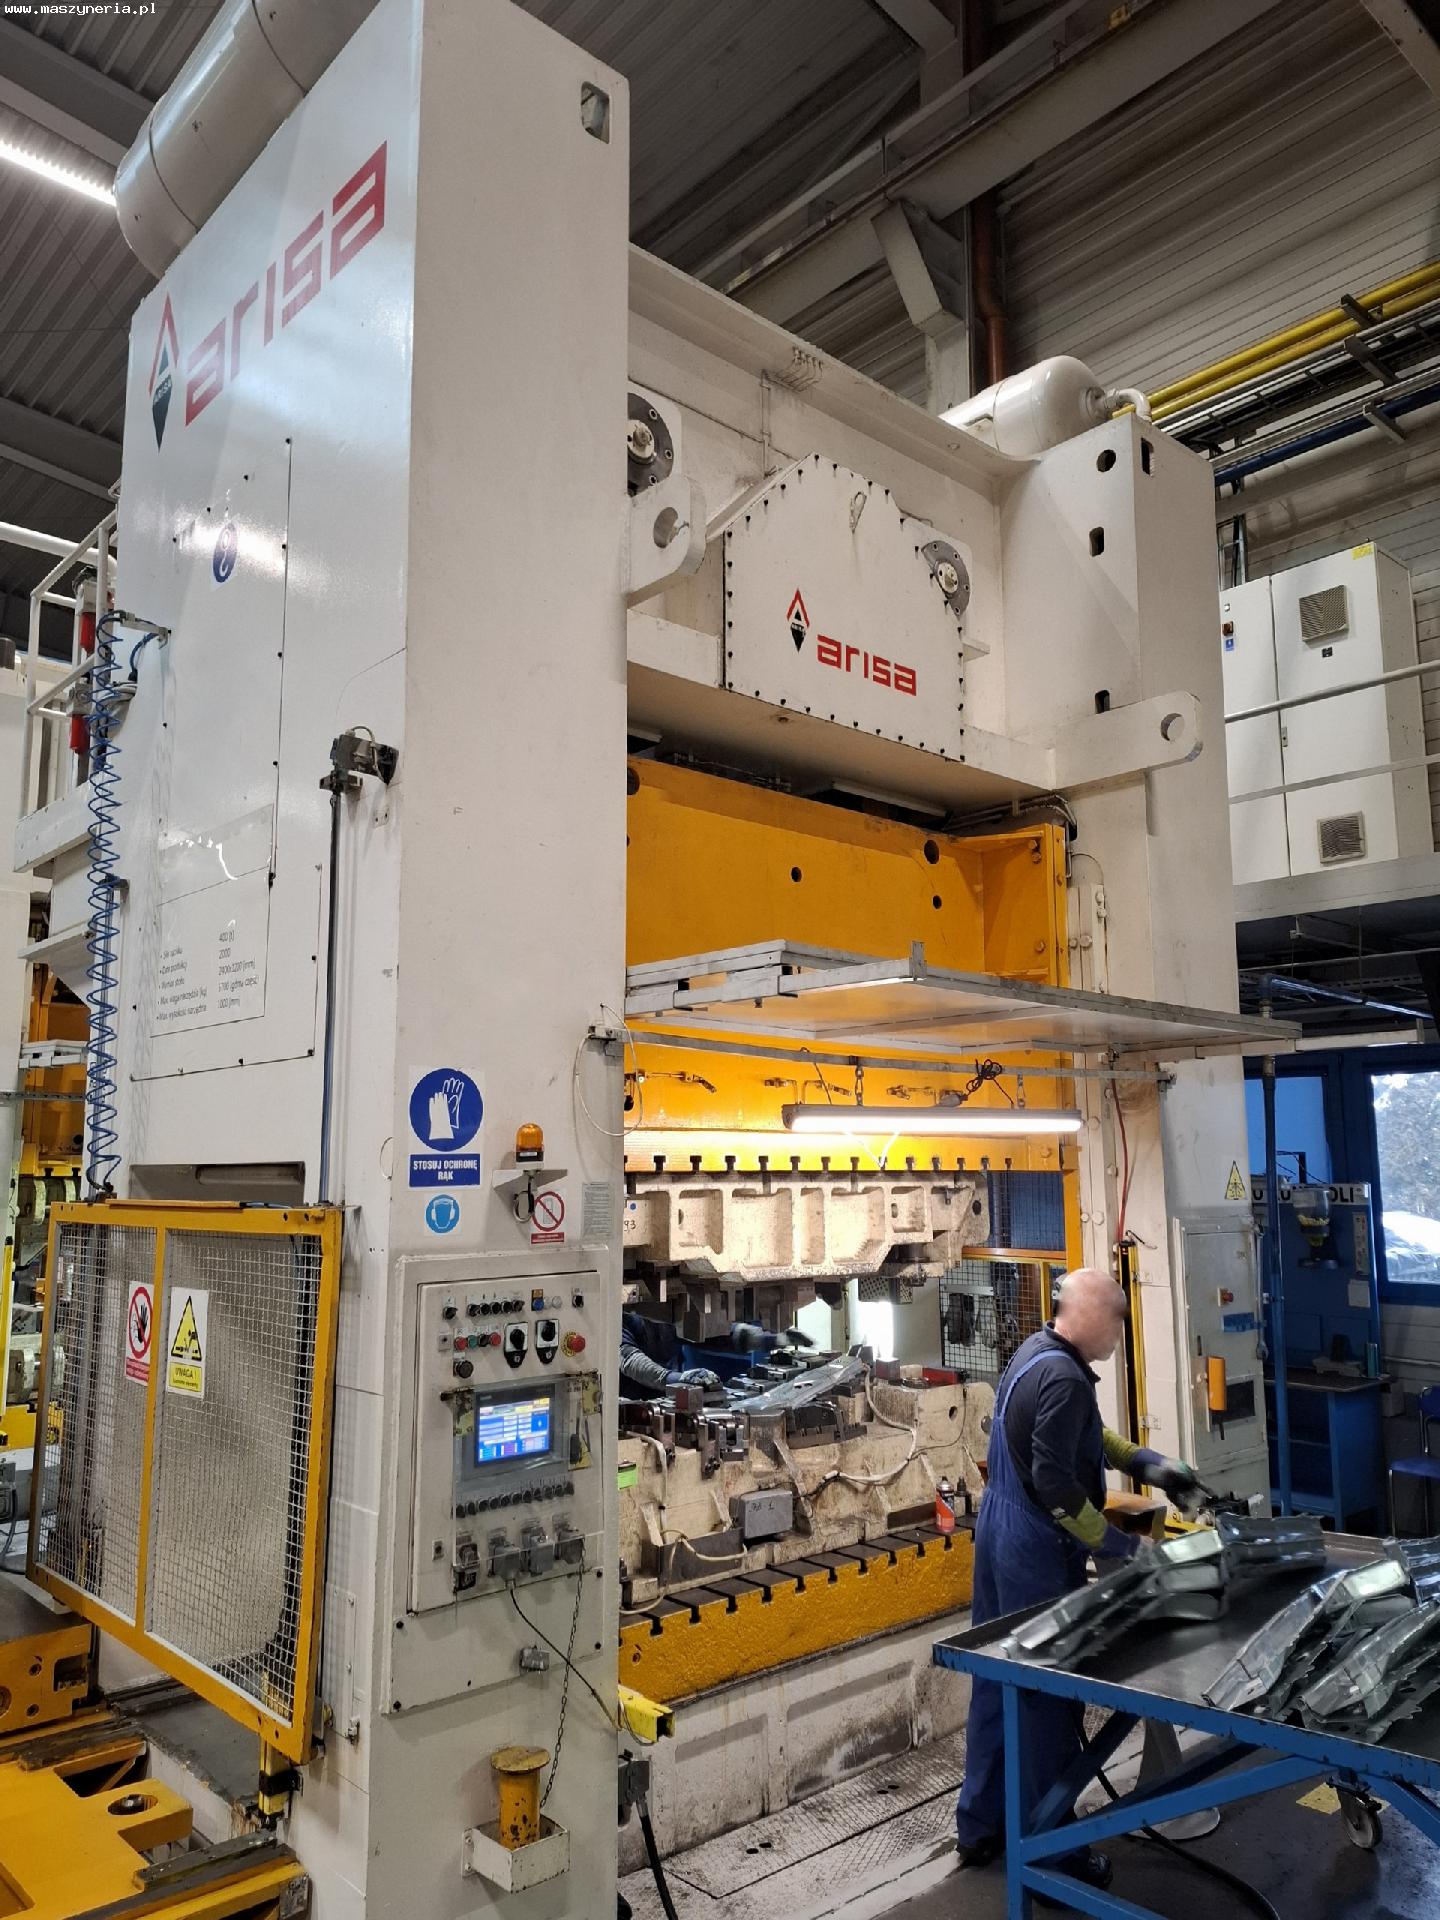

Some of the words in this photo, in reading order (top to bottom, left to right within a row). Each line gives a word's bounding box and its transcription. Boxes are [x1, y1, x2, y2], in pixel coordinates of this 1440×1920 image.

[184, 140, 388, 427] arisa
[816, 633, 917, 697] arisa
[413, 1160, 442, 1171] STOSUJ
[443, 1159, 478, 1171] OCHRONĘ
[437, 1171, 454, 1182] RĄK
